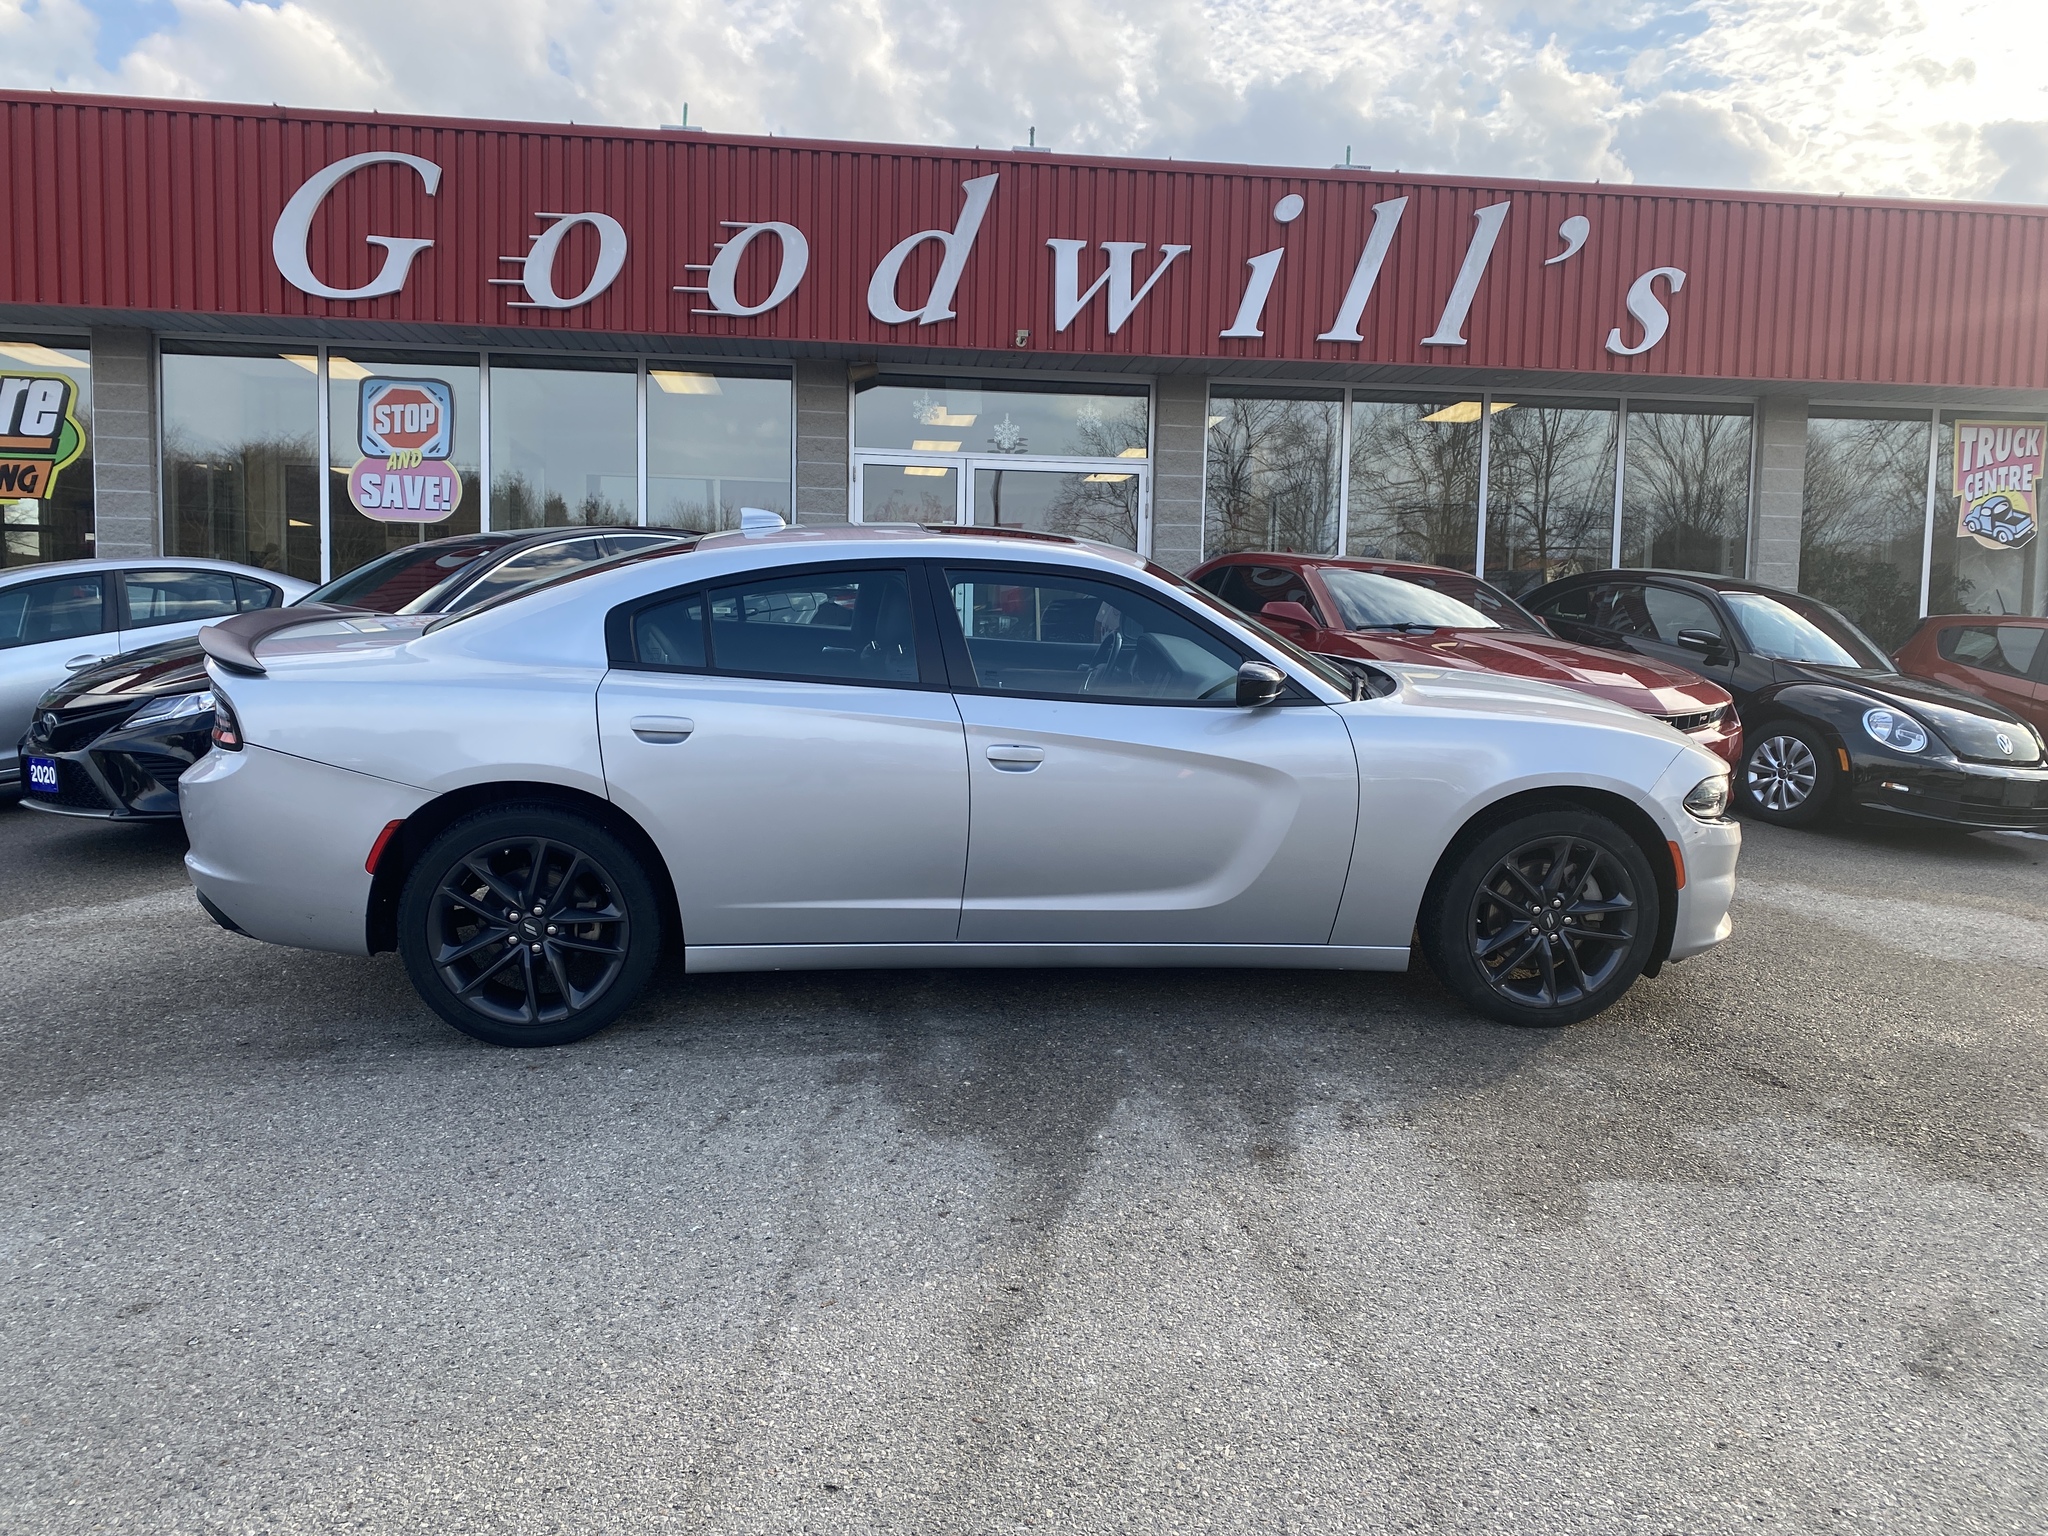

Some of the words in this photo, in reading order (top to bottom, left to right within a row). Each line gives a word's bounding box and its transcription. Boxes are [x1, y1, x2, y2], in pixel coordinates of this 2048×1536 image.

[272, 151, 1687, 356] Goodwill's
[375, 403, 436, 435] STOP
[386, 449, 423, 471] AND
[1960, 427, 2041, 472] TRUCK
[360, 473, 452, 511] SAVE!
[1964, 463, 2033, 502] CENTRE
[30, 764, 56, 785] 2020
